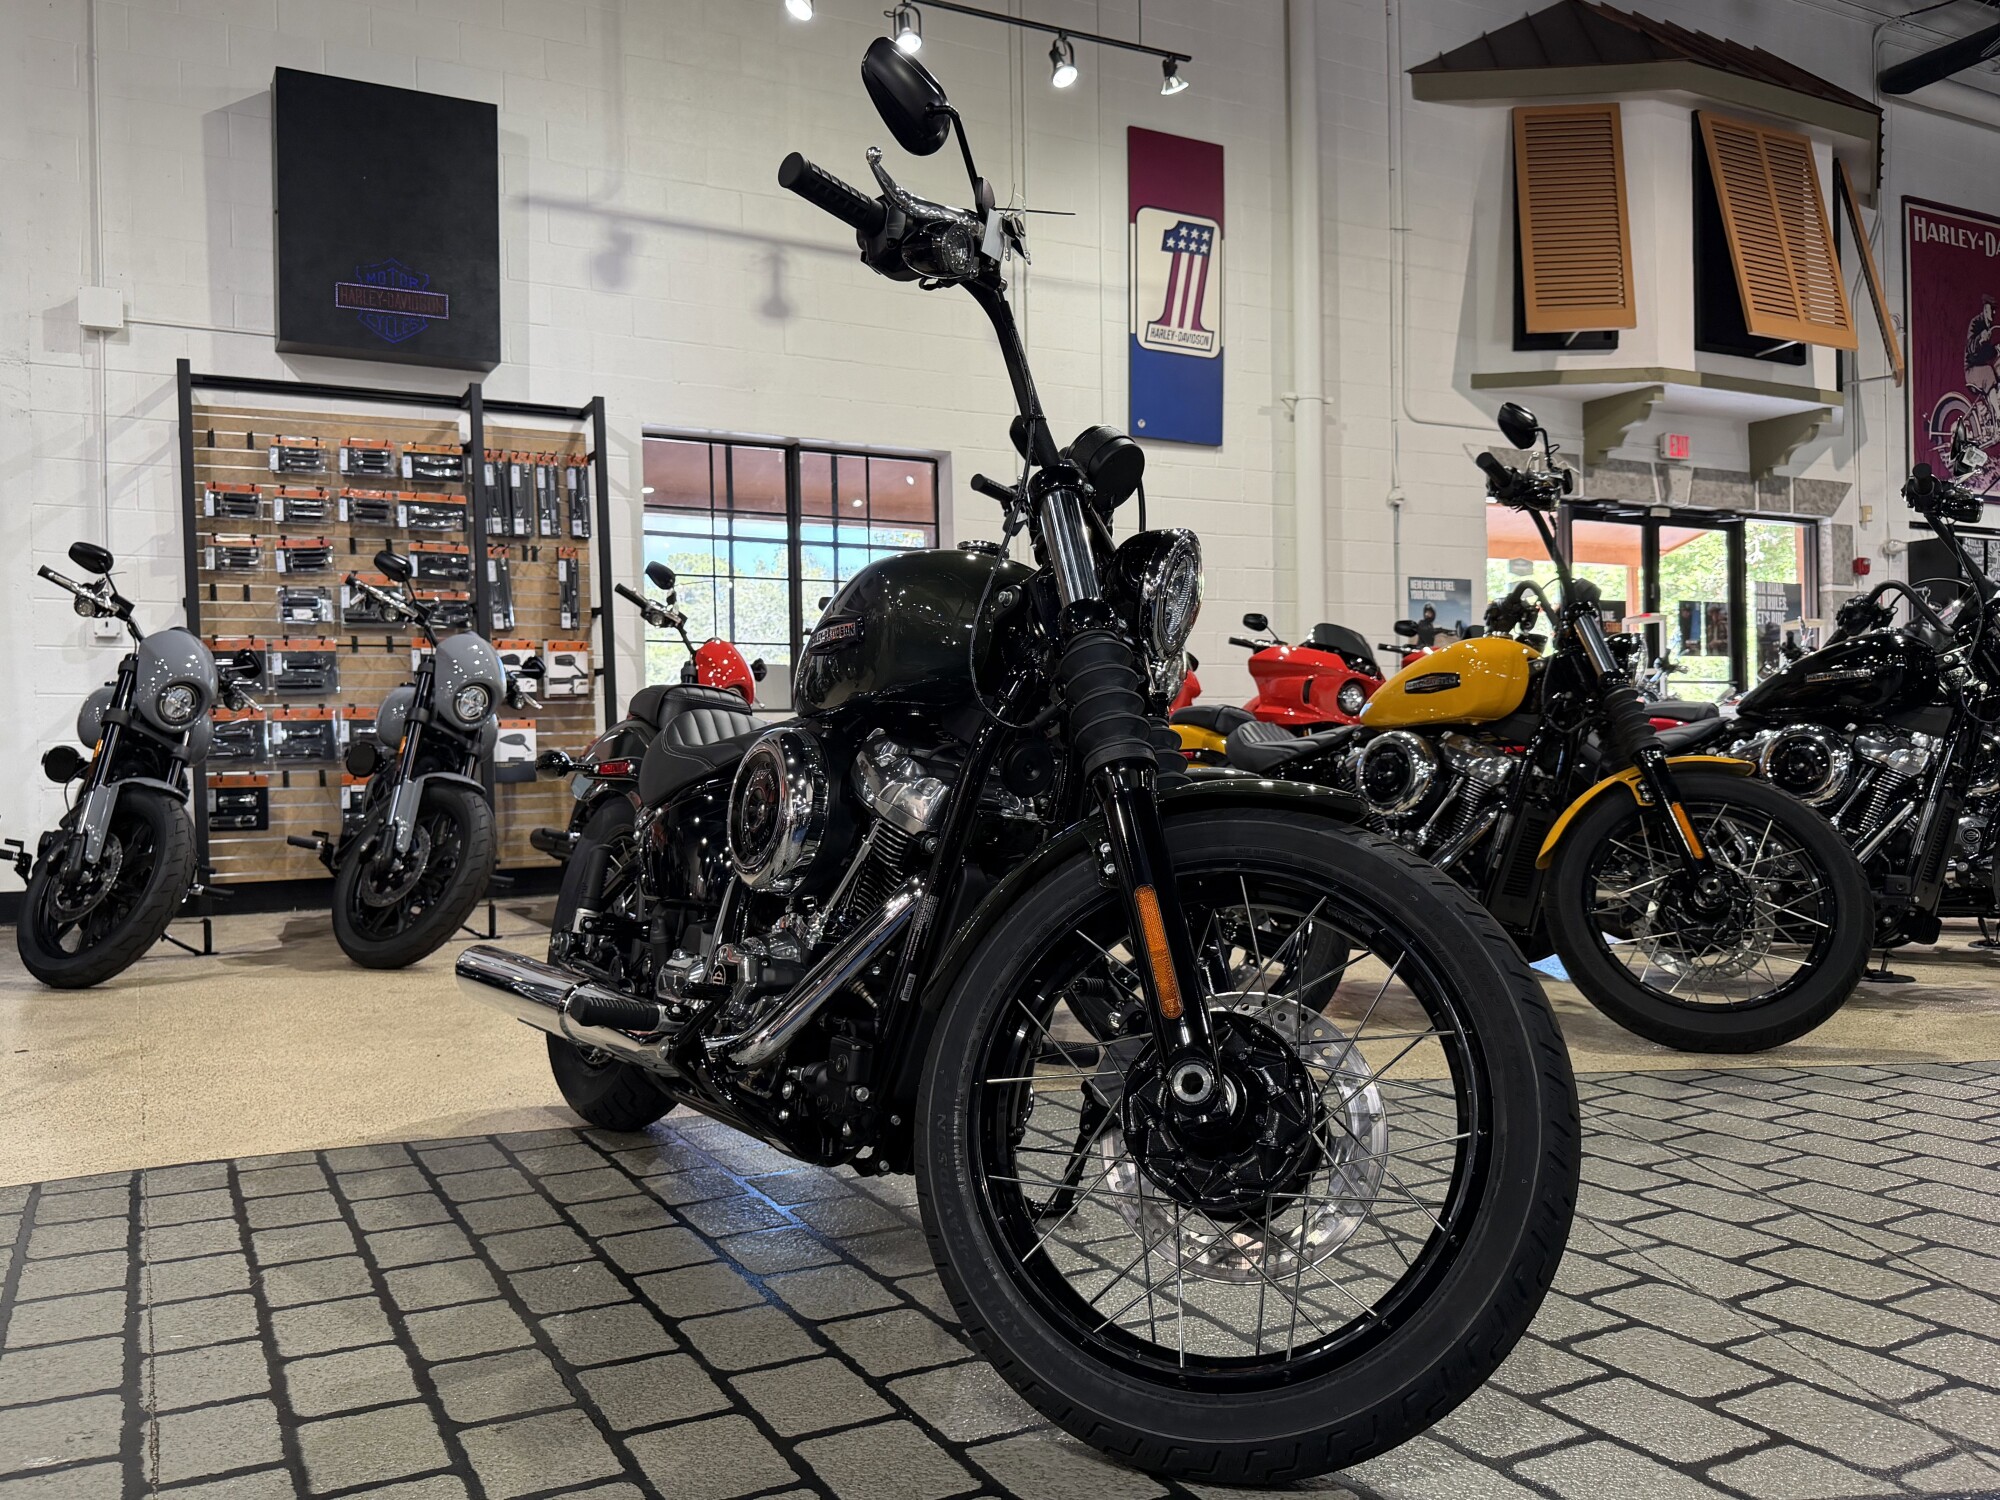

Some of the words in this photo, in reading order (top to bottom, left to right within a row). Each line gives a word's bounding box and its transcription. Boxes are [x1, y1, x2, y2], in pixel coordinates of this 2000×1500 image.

[366, 267, 419, 288] MOTOR
[341, 286, 444, 313] HARLEY-DAVIDSON
[366, 314, 418, 337] CYCLES
[1150, 327, 1210, 347] HARLEY-DAVIDSON
[1670, 434, 1689, 458] EXIT
[1755, 596, 1766, 610] UR
[1757, 611, 1770, 625] ET'S
